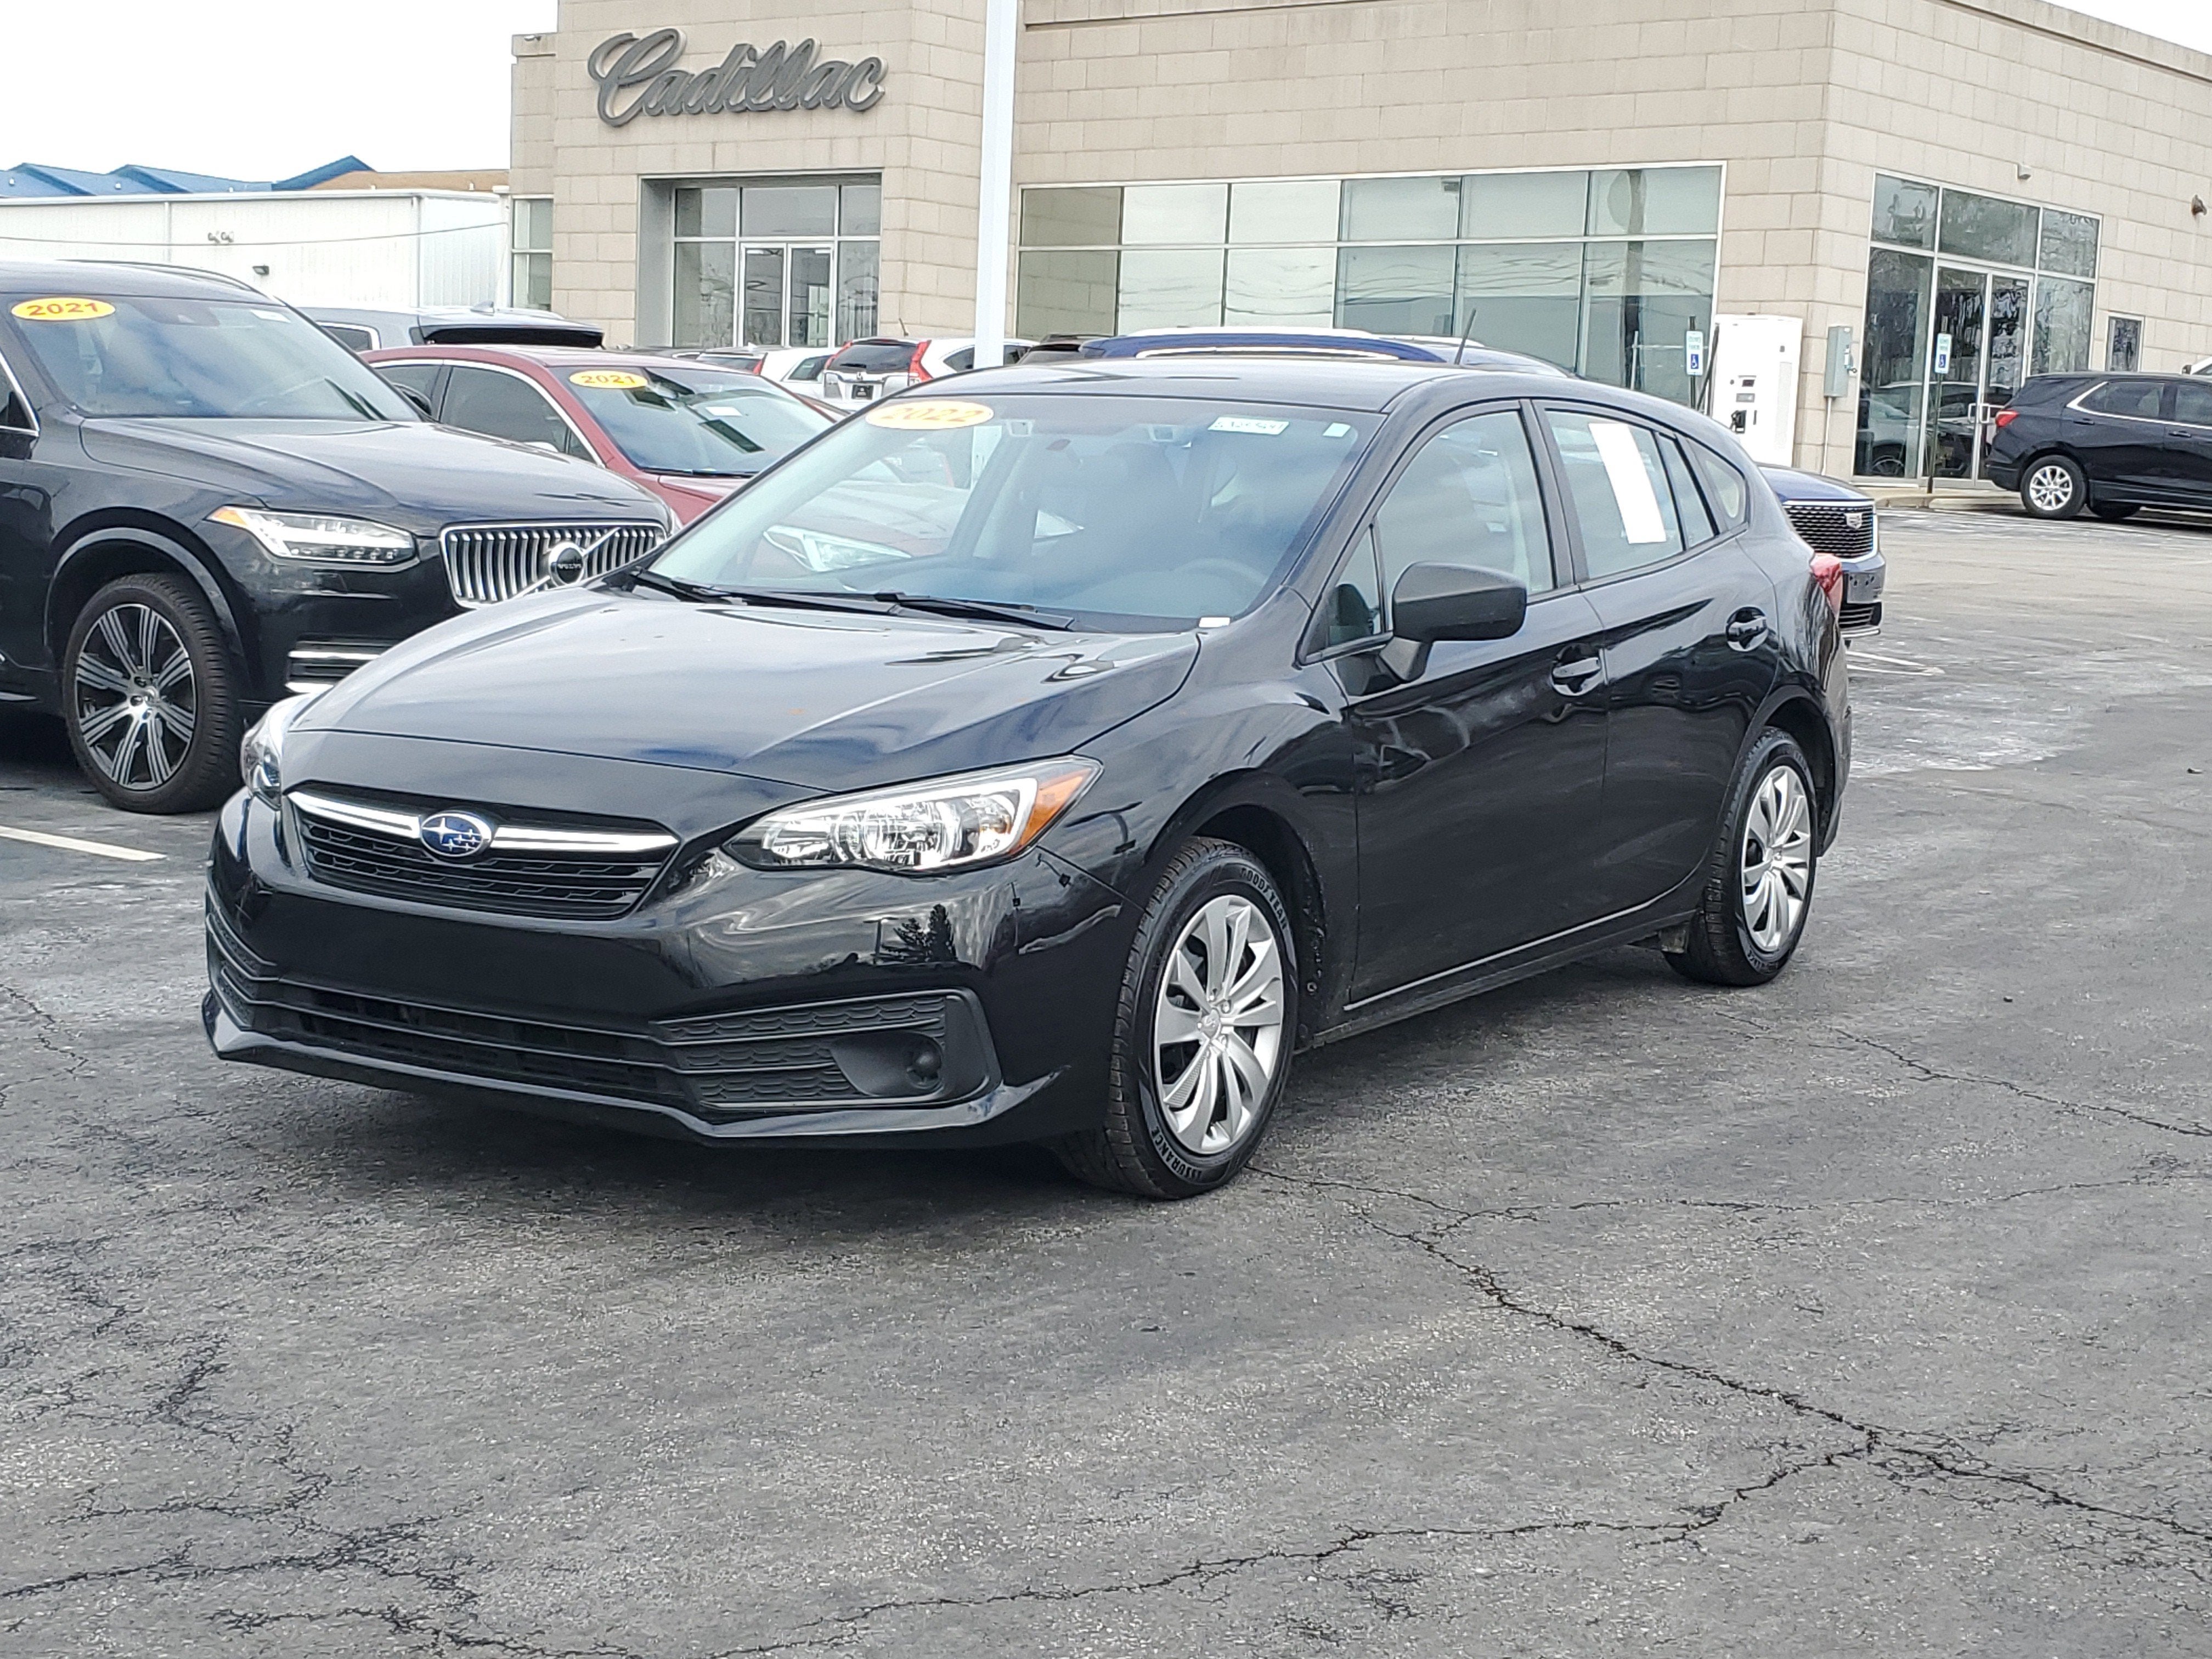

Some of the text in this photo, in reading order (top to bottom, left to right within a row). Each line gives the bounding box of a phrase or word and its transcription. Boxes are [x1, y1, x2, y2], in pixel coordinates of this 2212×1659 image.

[588, 27, 888, 127] Cadillac
[27, 303, 98, 316] 2021
[582, 375, 635, 383] 2021
[880, 408, 984, 422] 2022
